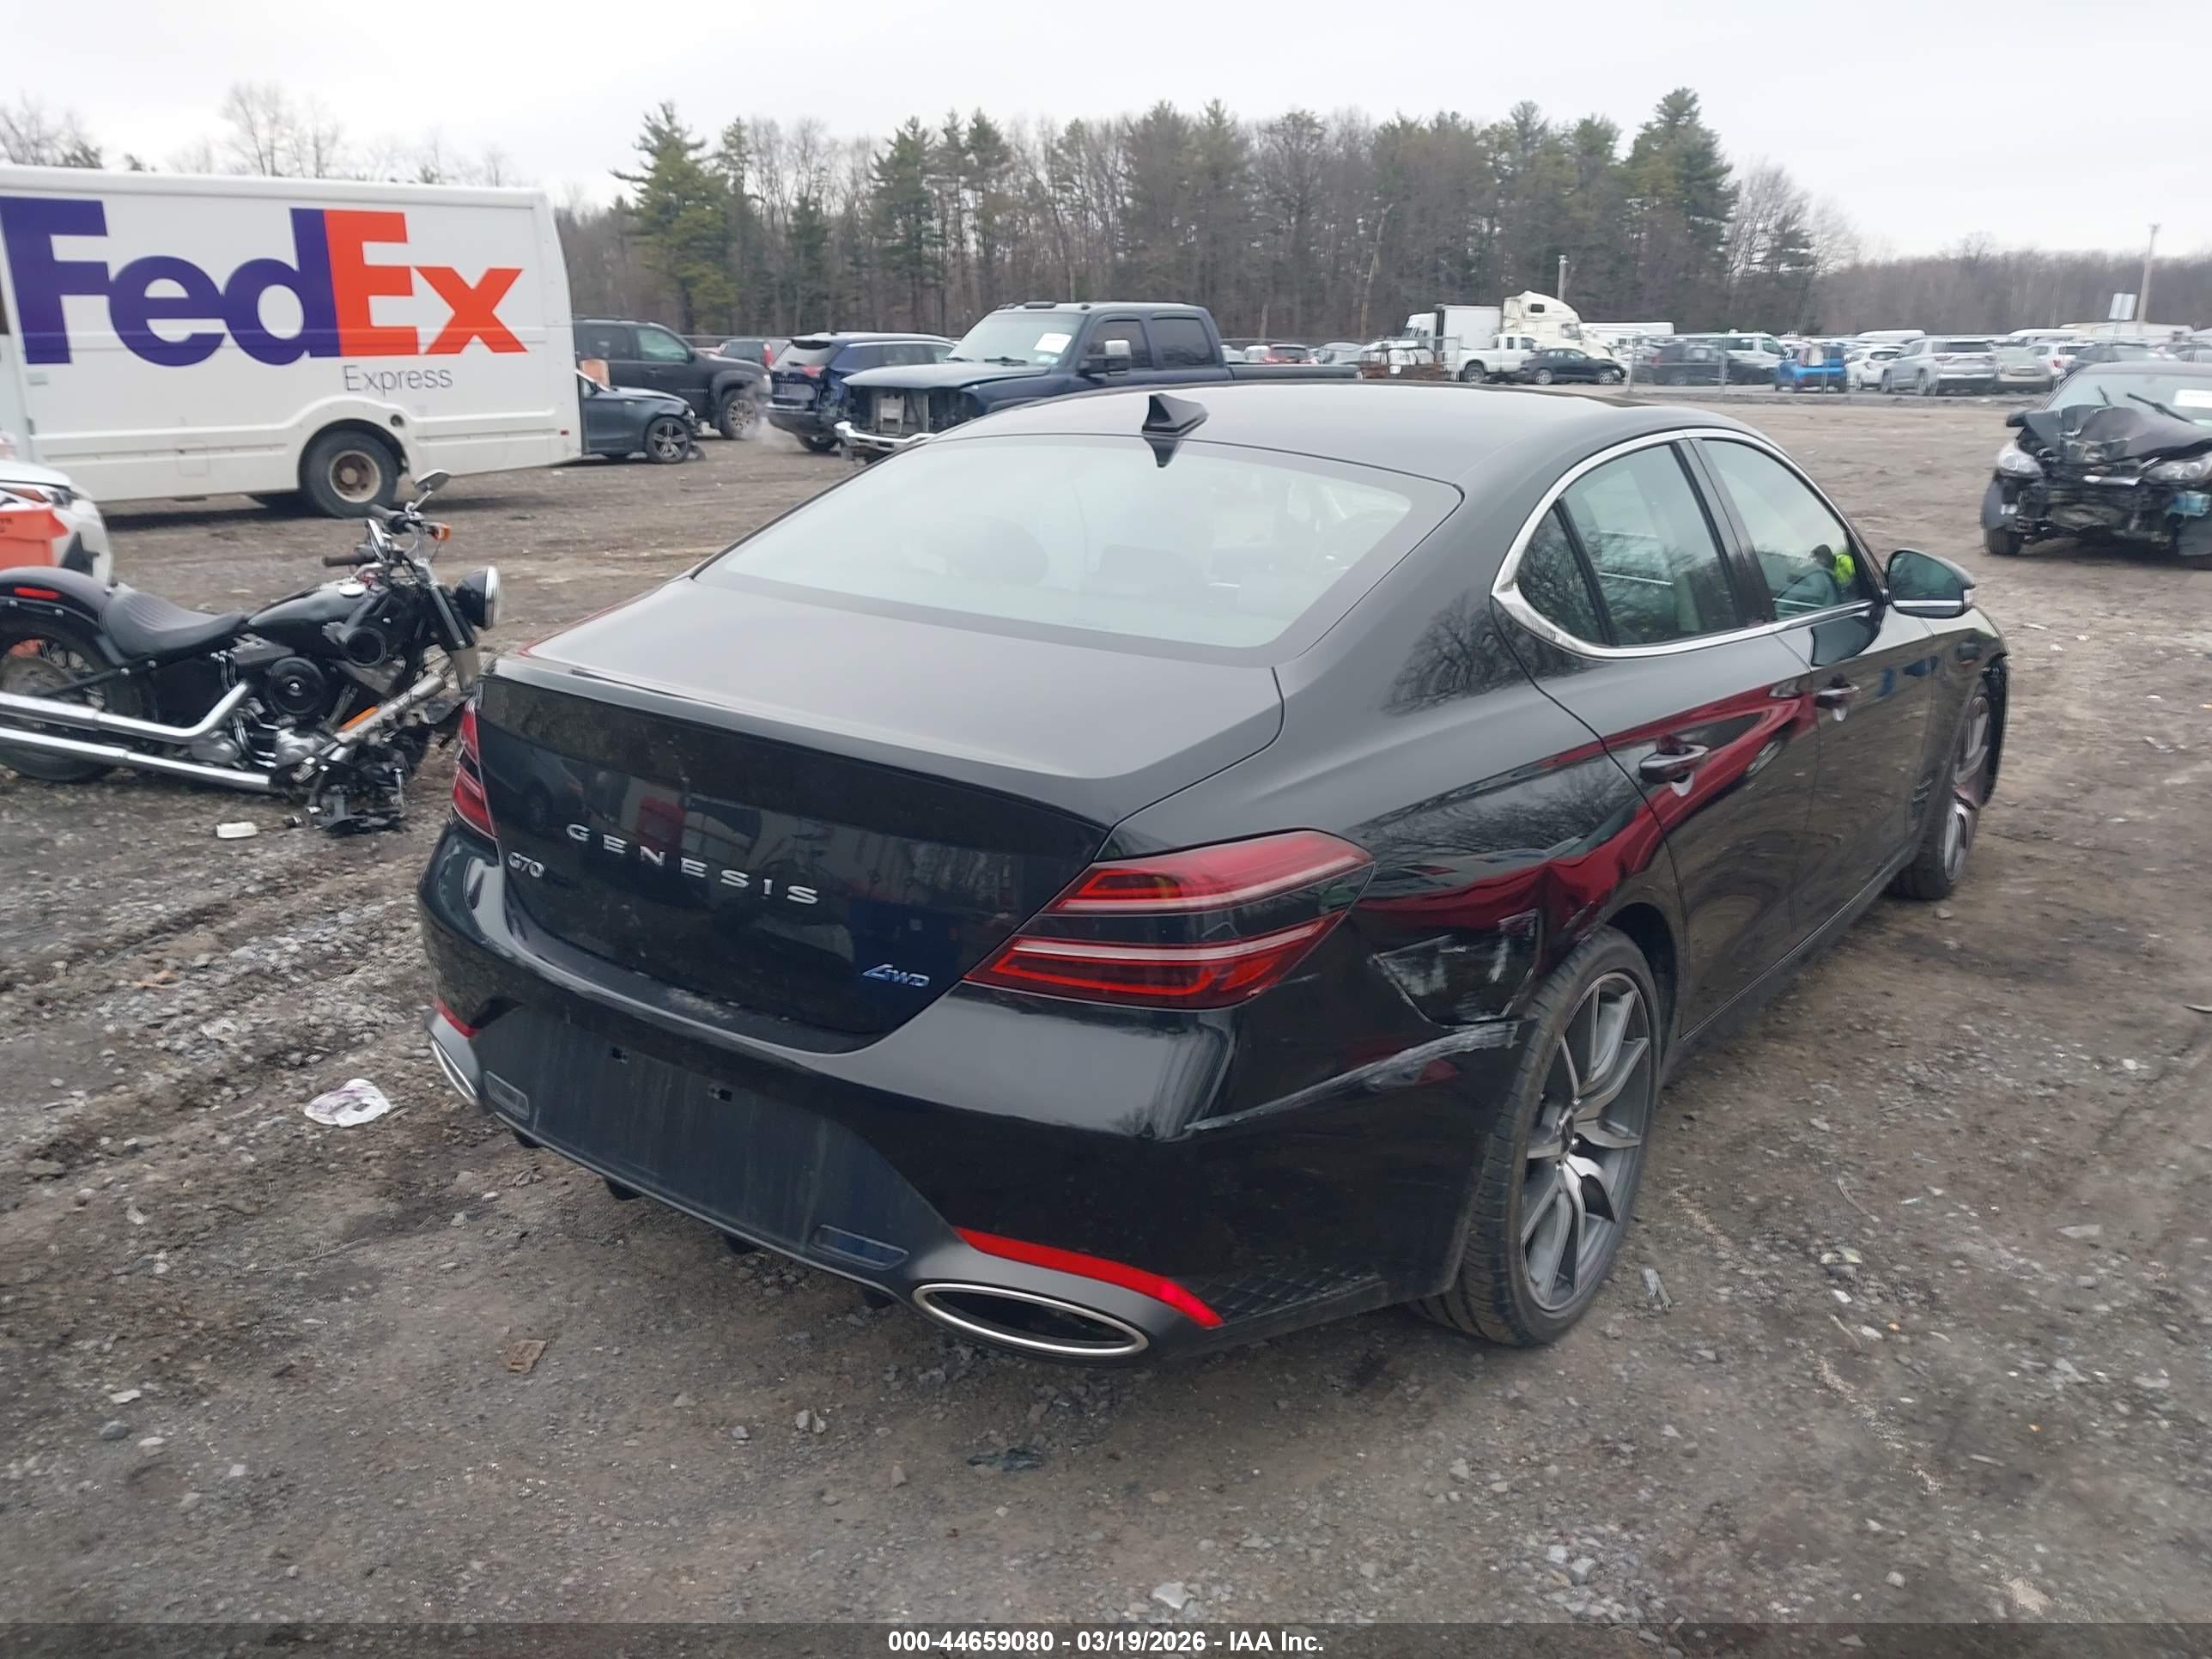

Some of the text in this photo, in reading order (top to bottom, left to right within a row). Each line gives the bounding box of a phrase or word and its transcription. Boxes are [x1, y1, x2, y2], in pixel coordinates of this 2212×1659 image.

[0, 197, 529, 367] FedEx
[342, 364, 453, 397] Express
[507, 851, 544, 878] G70
[566, 823, 818, 906] GENESIS
[861, 963, 931, 988] AWD
